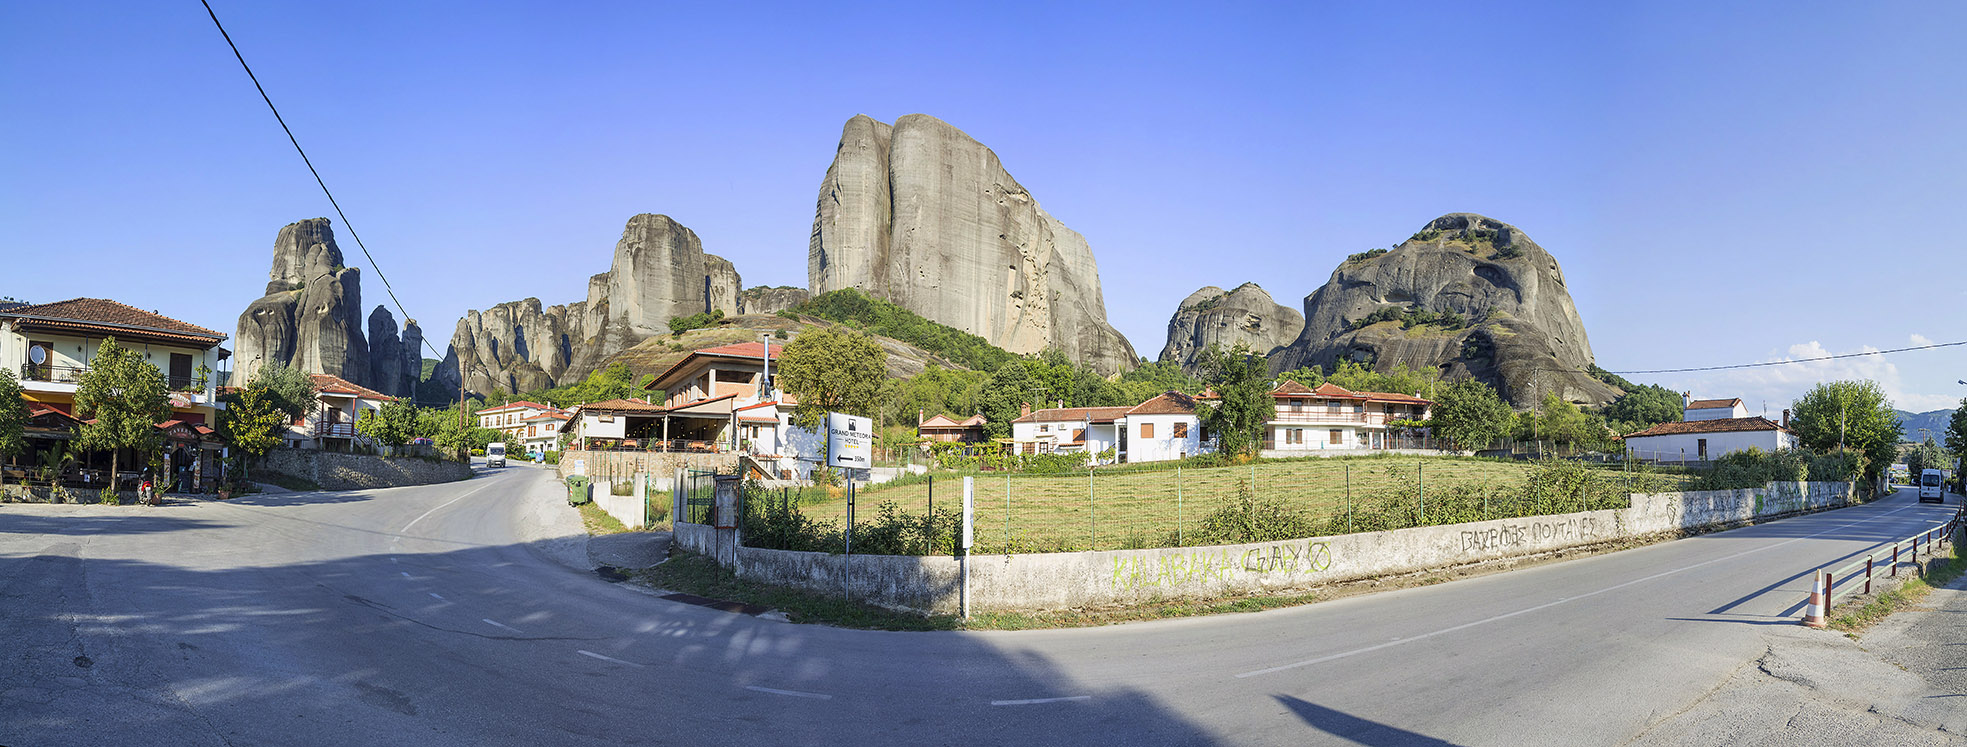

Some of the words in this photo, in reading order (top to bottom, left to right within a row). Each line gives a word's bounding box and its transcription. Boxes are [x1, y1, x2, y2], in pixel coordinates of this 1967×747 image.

[831, 428, 850, 437] GRAND
[850, 432, 872, 440] METEORA
[1111, 548, 1234, 591] KALABAKA
[1246, 545, 1302, 577] GAY
